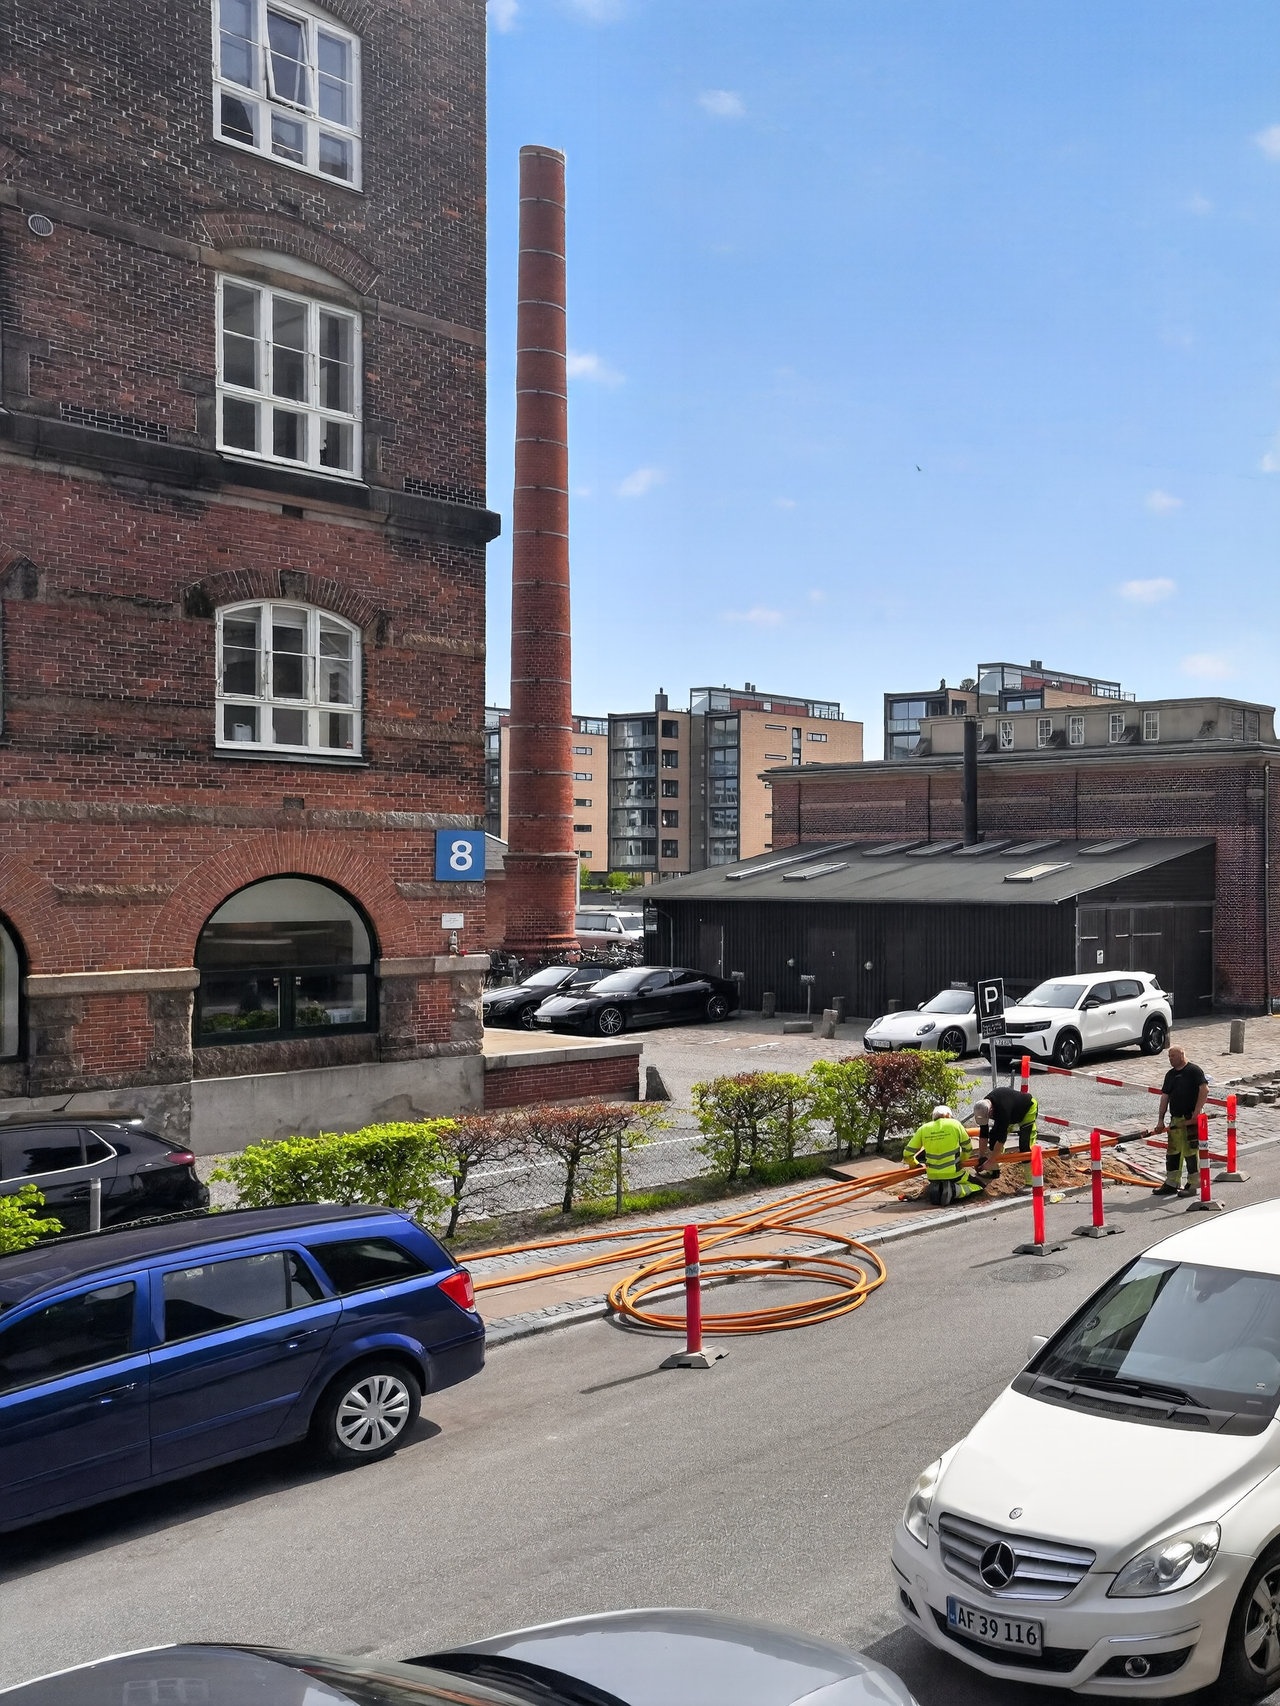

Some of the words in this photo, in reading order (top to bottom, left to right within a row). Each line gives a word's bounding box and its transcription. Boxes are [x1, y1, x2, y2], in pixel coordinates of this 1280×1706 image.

[449, 840, 473, 871] 8
[984, 986, 999, 1013] P
[958, 1607, 975, 1629] AF
[979, 1615, 999, 1639] 39
[1004, 1622, 1037, 1646] 116
